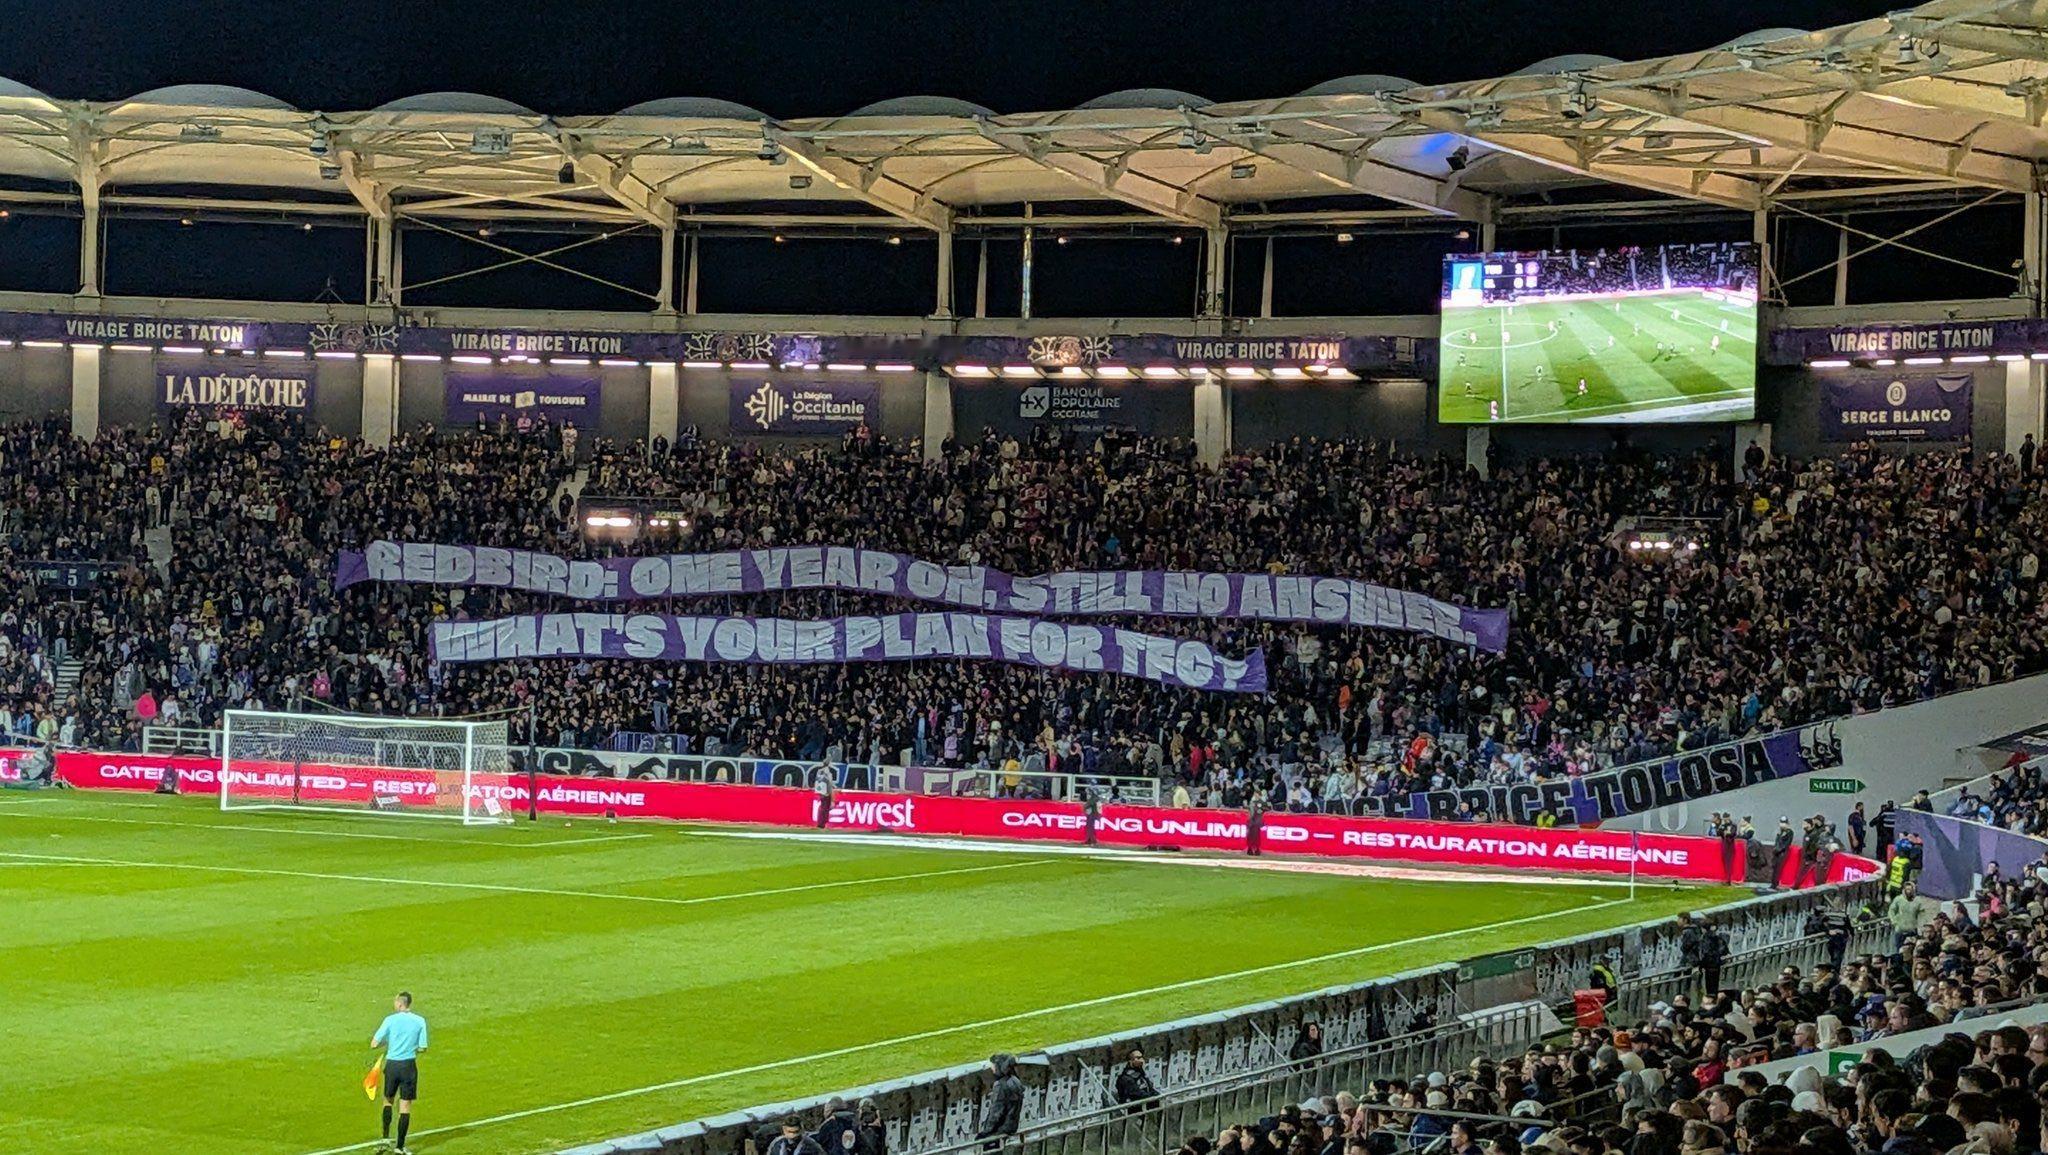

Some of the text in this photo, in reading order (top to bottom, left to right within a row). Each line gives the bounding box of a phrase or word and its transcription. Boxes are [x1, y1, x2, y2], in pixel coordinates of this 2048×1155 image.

[66, 320, 244, 344] VIRAGE BRICE TATON
[1831, 327, 1994, 352] VIRAGE BRICE TATON
[451, 333, 622, 355] VIRAGE BRICE TATON
[1176, 341, 1341, 361] VIRAGE BRICE TATON
[165, 373, 307, 408] LA DÉPÊCHE
[462, 394, 586, 406] MAIRIE DE TOULOUSE
[792, 391, 803, 400] La
[1053, 387, 1104, 398] BANQUE
[792, 400, 865, 415] Occitanie
[1052, 397, 1121, 408] POPULAIRE
[1052, 409, 1100, 419] OCCITANE
[1841, 408, 1951, 425] SERGE BLANCO
[67, 568, 78, 587] 5
[366, 539, 619, 598] REDBIRD:
[630, 553, 744, 596] ONE
[750, 547, 897, 592] YEAR
[1010, 570, 1152, 613] STILL
[1163, 572, 1229, 616] NO
[434, 612, 1249, 690] WHAT'S YOUR PLAN FOR TFC?
[1426, 781, 1577, 828] BRICE
[1583, 740, 1778, 819] TOLOSA
[537, 786, 645, 806] AÉRIENNE
[1146, 819, 1309, 842] UNLIMIED
[1343, 830, 1547, 858] RESTAURATION
[1553, 839, 1689, 866] AÉRIENNE
